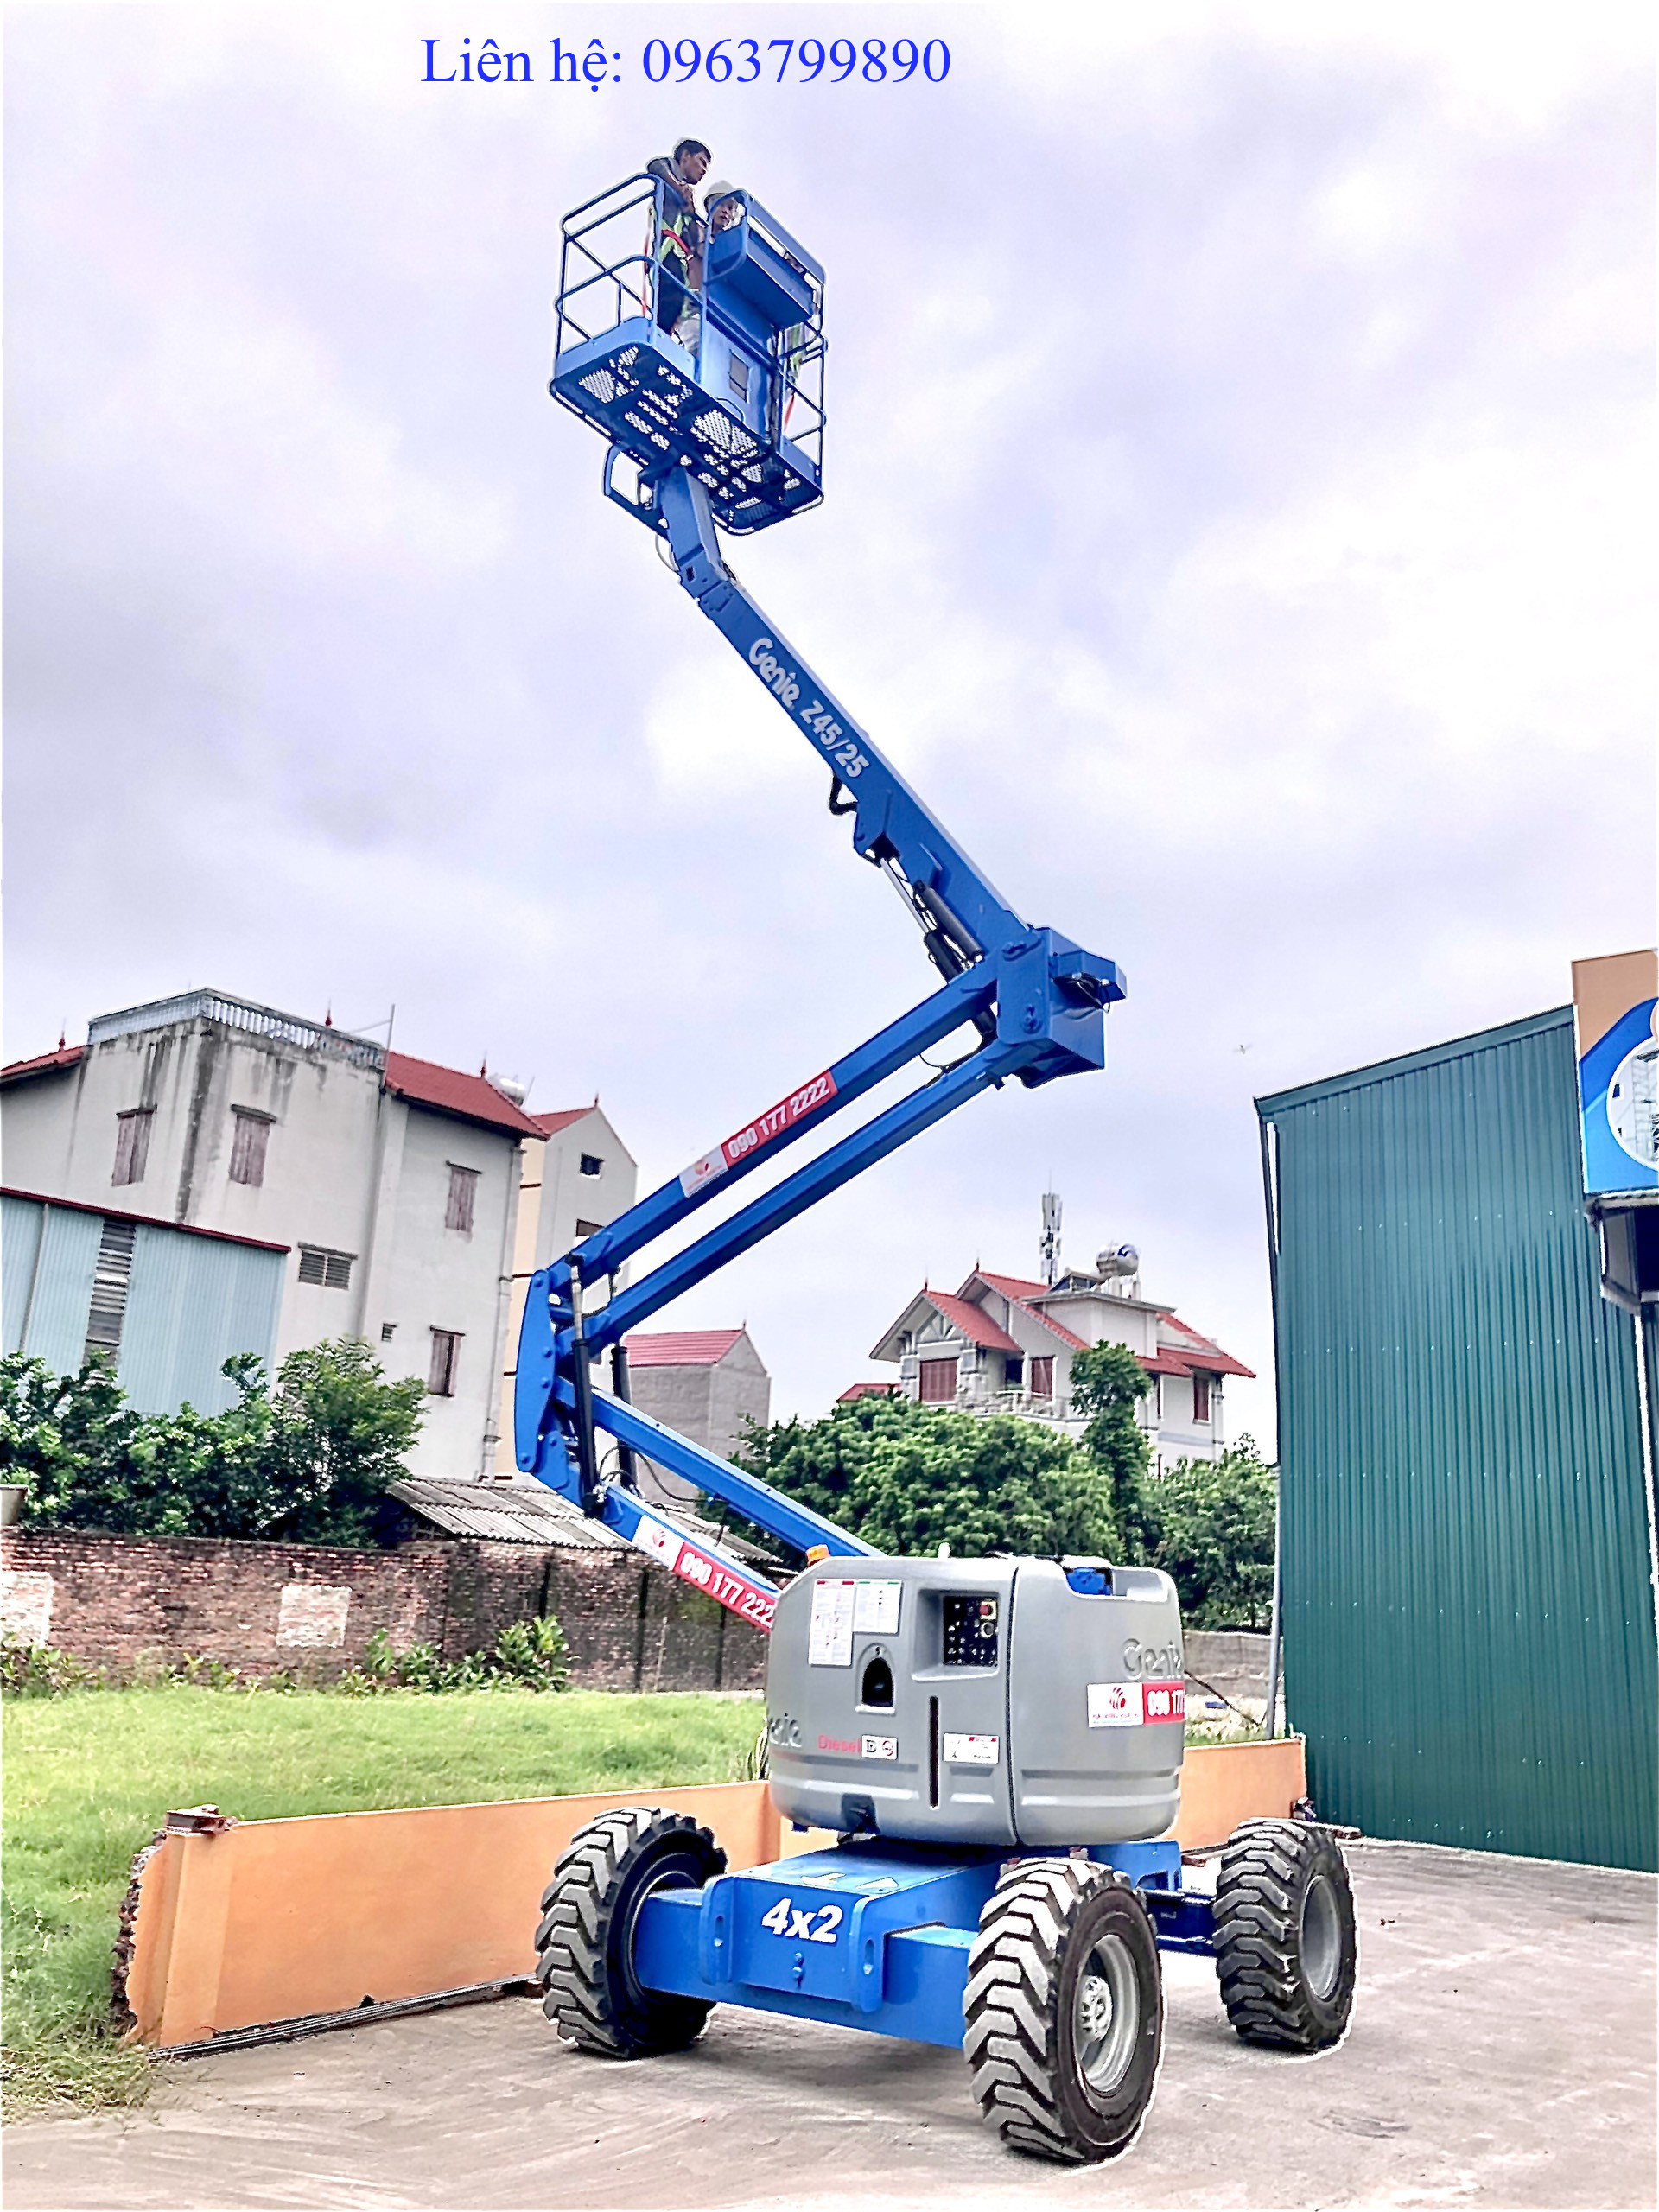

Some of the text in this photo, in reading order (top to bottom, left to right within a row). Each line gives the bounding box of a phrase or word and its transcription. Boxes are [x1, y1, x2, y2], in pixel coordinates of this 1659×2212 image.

[748, 637, 870, 778] Genie Z45/25
[728, 1077, 830, 1159] 090 177 2222
[680, 1551, 777, 1629] 090 177 222
[817, 1733, 861, 1754] Diesel
[761, 1897, 843, 1943] 4x2
